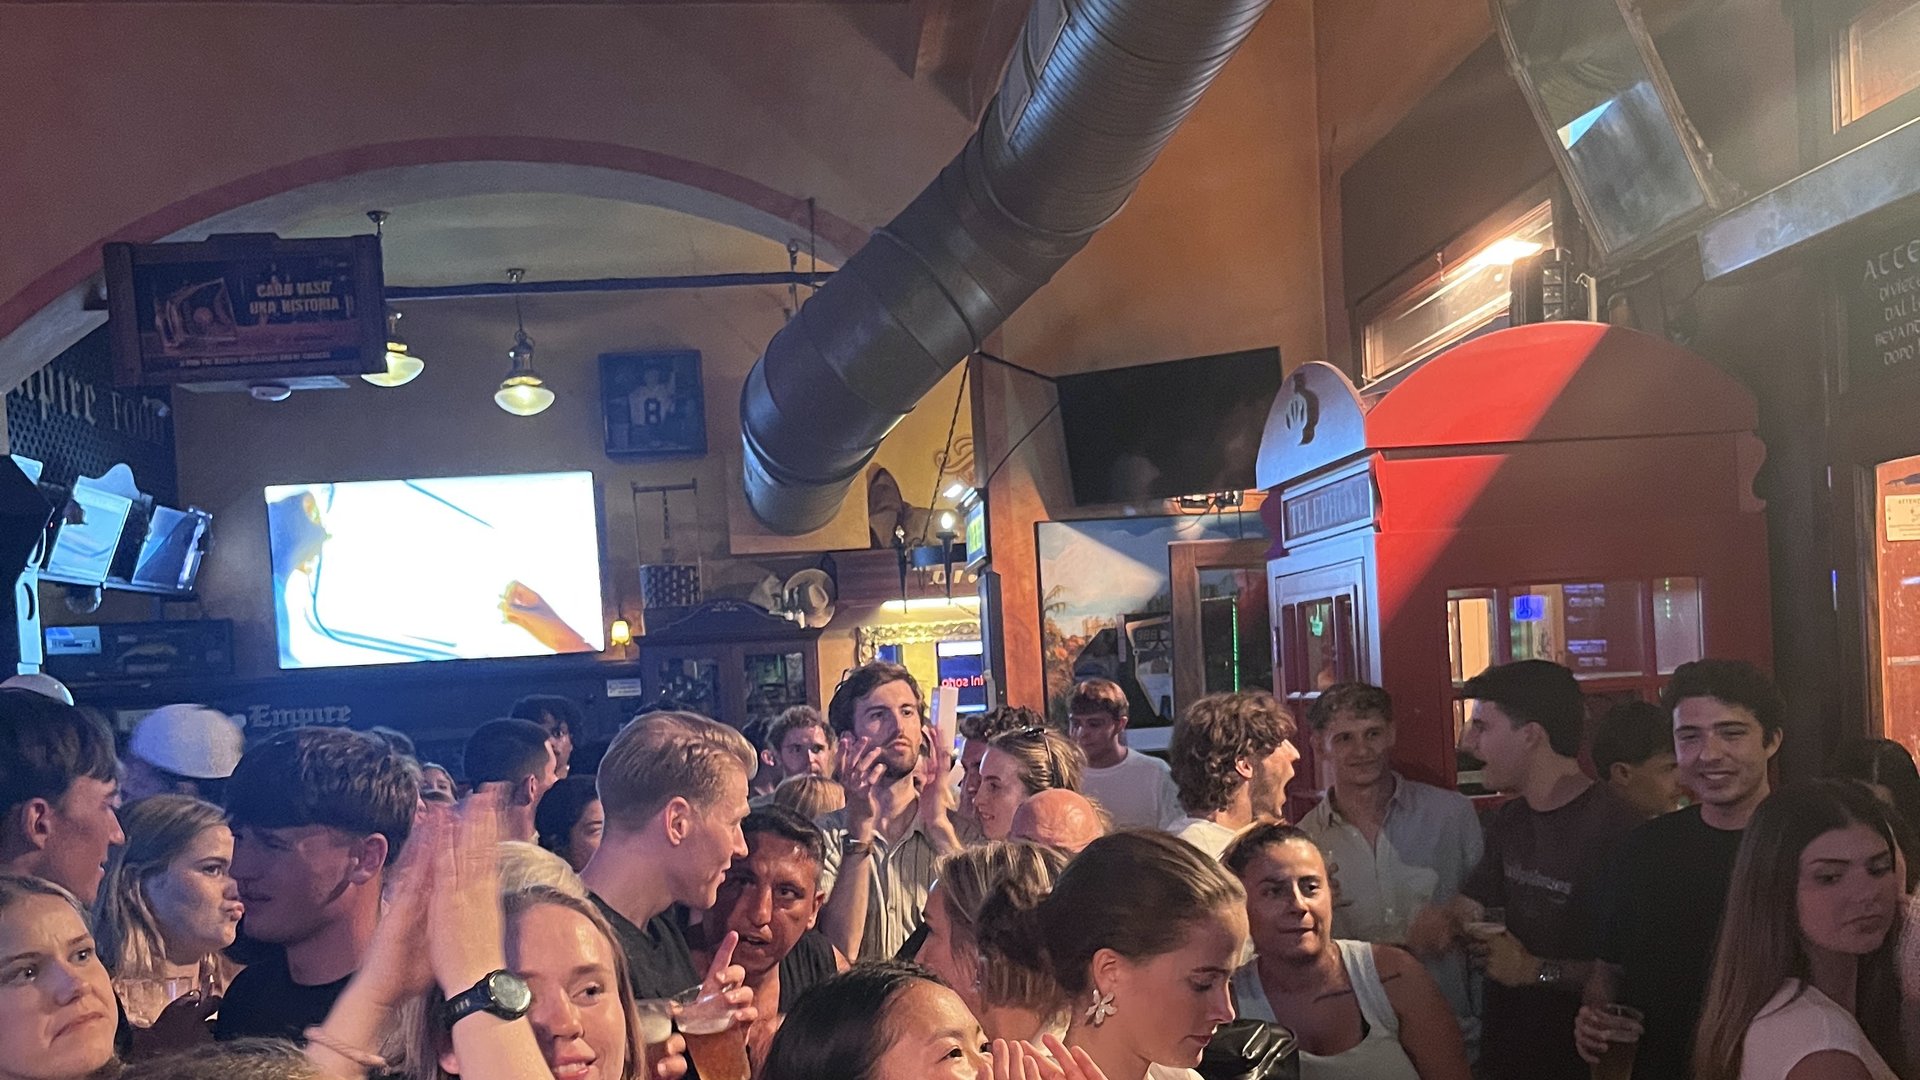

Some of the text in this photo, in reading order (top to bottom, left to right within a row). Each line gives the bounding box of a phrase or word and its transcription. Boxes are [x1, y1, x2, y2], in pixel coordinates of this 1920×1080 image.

[256, 281, 332, 297] CADA VASO
[249, 297, 340, 315] UNA HISTORIA
[1289, 482, 1368, 535] TELEPHONE
[249, 704, 351, 728] Empire
